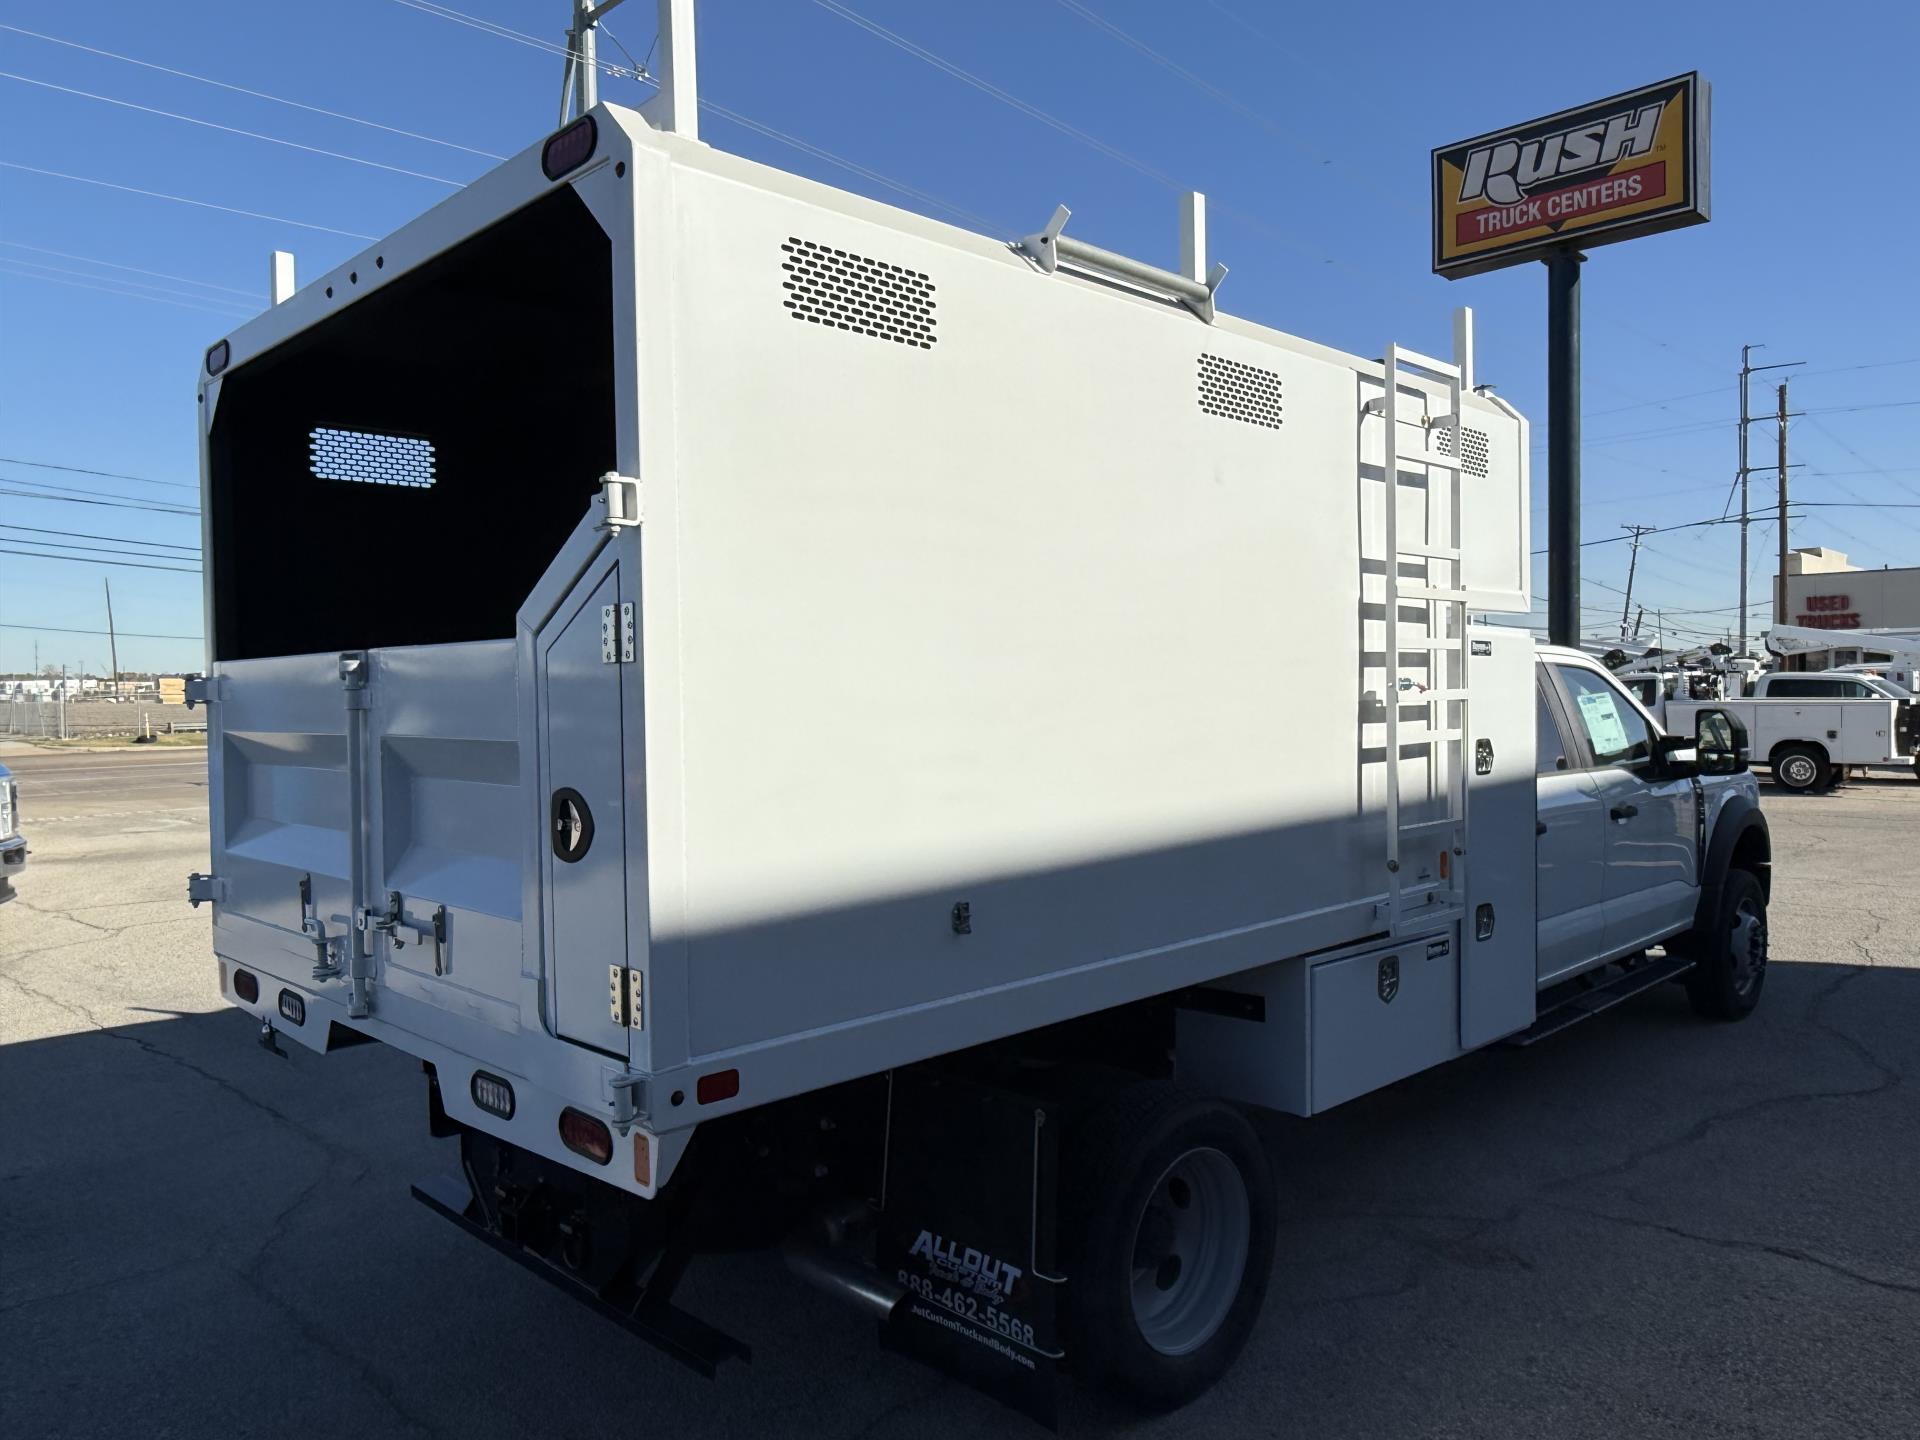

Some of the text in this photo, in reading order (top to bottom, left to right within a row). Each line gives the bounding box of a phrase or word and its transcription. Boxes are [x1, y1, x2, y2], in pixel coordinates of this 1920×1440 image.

[1457, 101, 1665, 207] RUSH
[1476, 174, 1642, 234] TRUCK CENTERS
[1796, 612, 1861, 630] TRUCKS
[1806, 595, 1850, 612] USED
[909, 1229, 1023, 1296] ALLOUT
